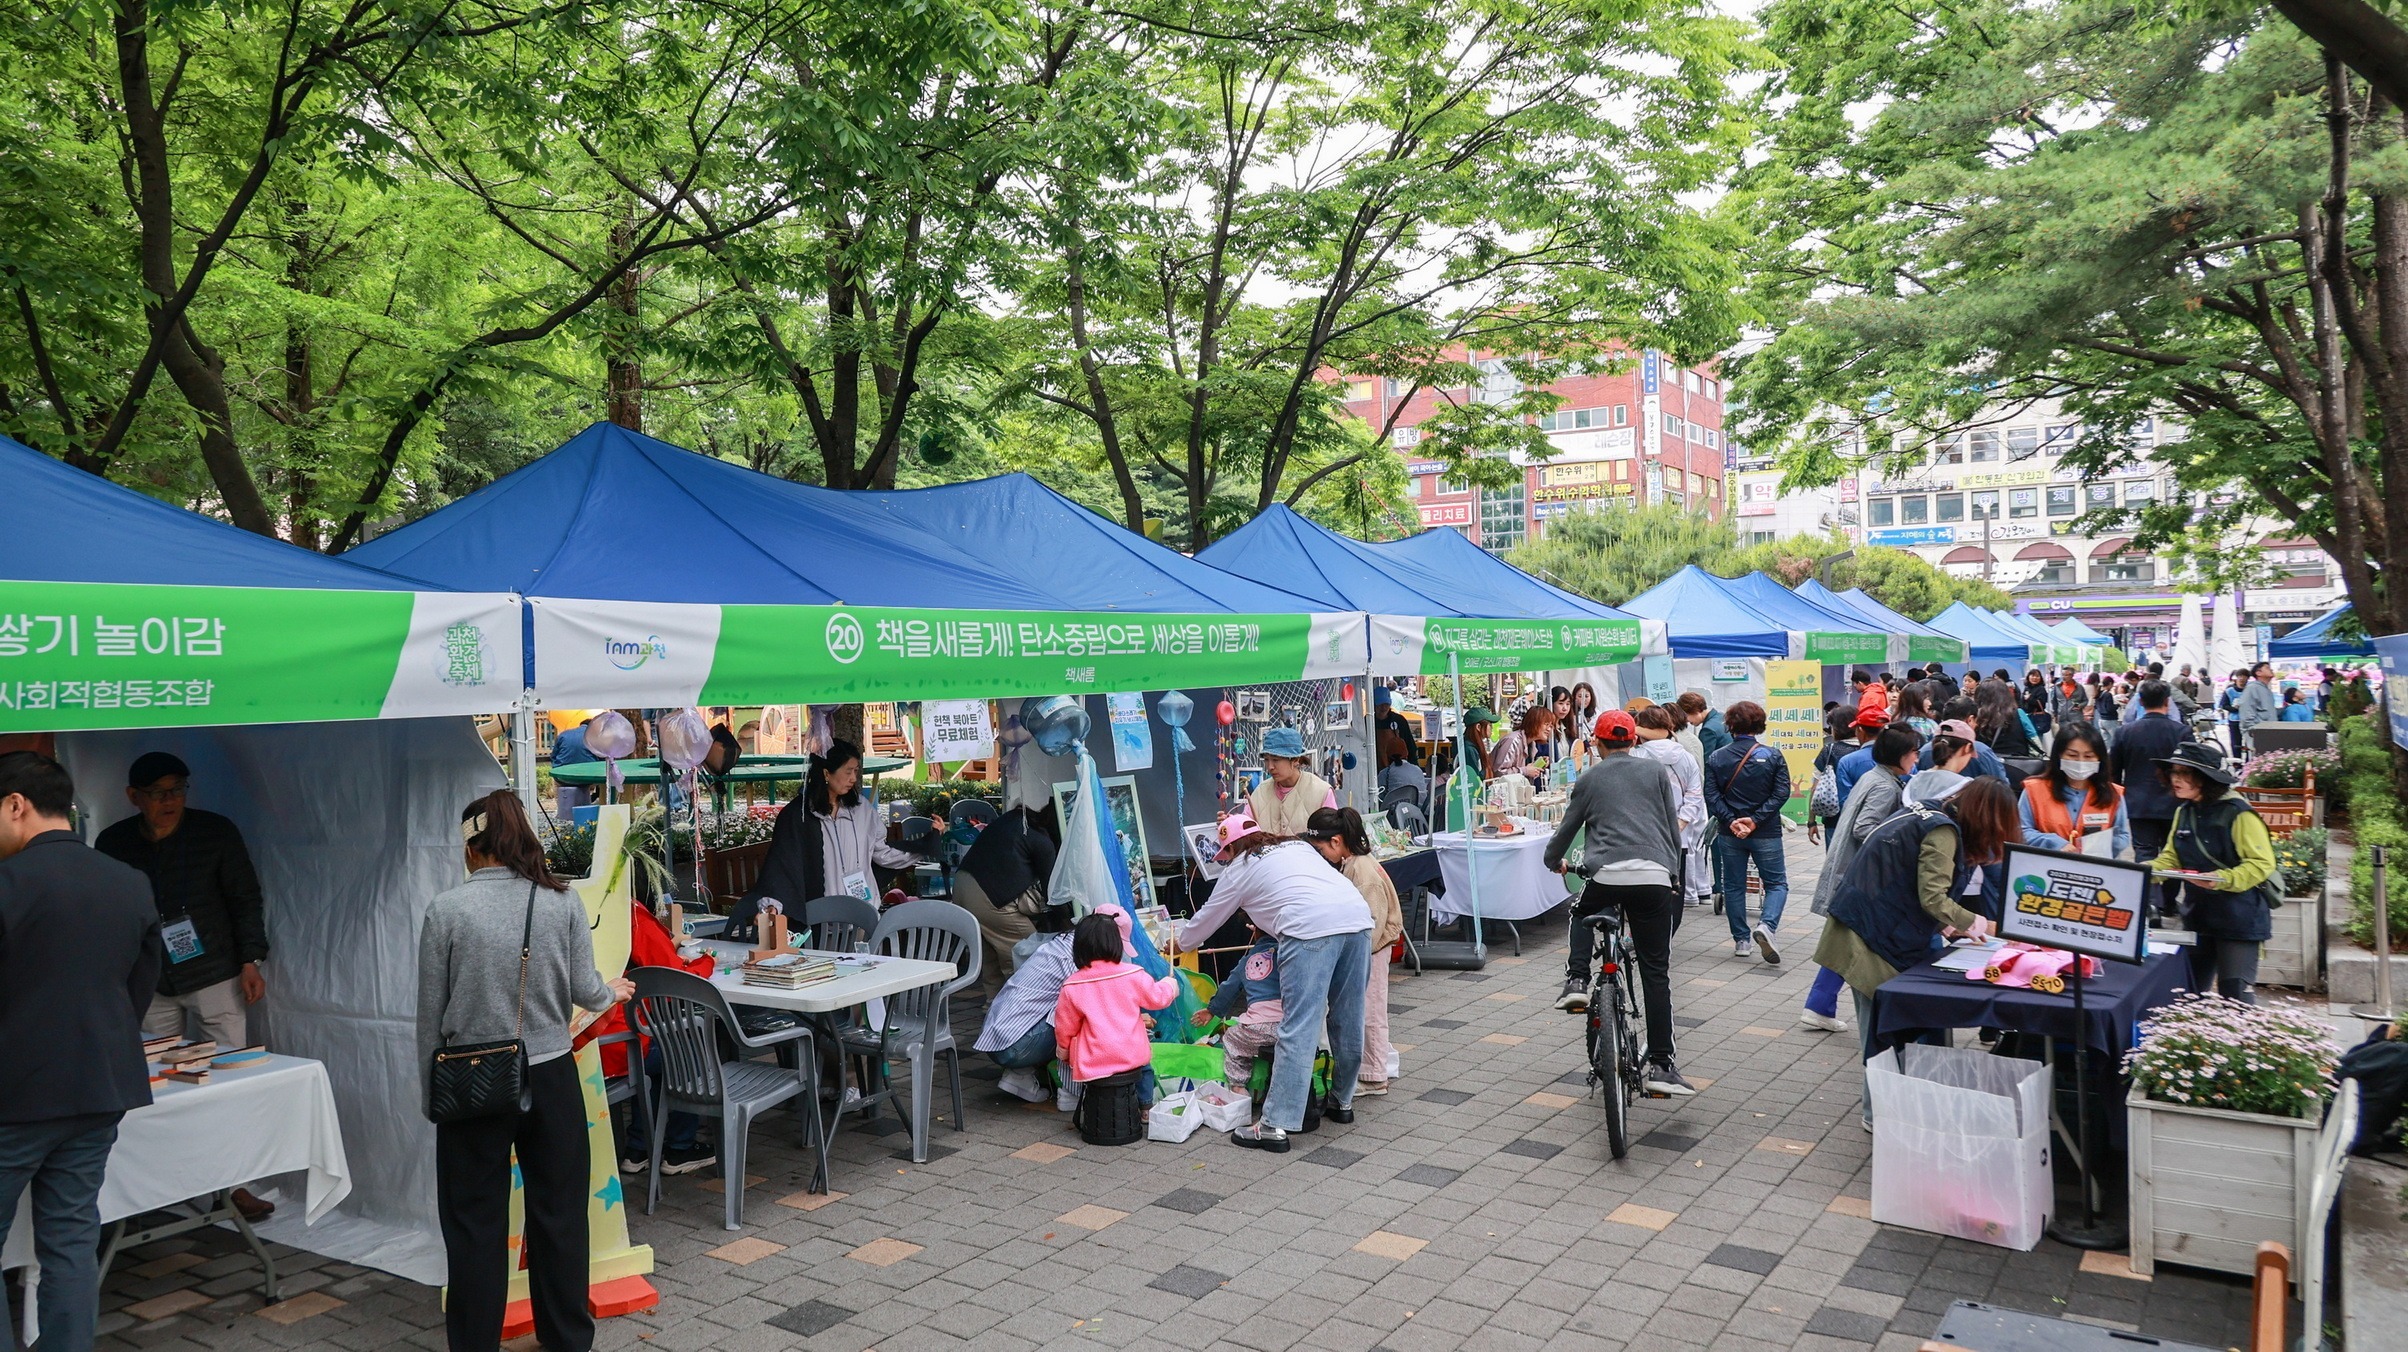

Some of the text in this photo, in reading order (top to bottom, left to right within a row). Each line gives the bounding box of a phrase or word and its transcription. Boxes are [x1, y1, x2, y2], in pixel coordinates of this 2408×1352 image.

[1556, 465, 1582, 477] 한수위
[2016, 493, 2029, 505] 방
[1421, 508, 1465, 522] 물리치료
[2050, 600, 2071, 610] CU
[94, 615, 226, 656] 놀이감
[447, 626, 478, 645] 과천
[830, 624, 859, 651] 20
[1018, 622, 1146, 657] 탄소중립으로
[1151, 623, 1204, 655] 세상을
[1208, 623, 1260, 653] 이롭게!
[1445, 628, 1469, 651] 지구를
[1470, 628, 1492, 651] 살리는
[448, 645, 479, 663] 환경
[450, 662, 481, 681] 축제
[1065, 667, 1095, 683] 책새롬
[0, 679, 215, 710] 사회적협동조합
[933, 713, 978, 727] 헌책 북아트
[938, 727, 979, 743] 무료체험
[1771, 729, 1819, 738] 세대와 세대가
[1773, 742, 1794, 751] 세상을
[2049, 882, 2096, 903] 도전!
[2017, 893, 2132, 931] 환경골든벨
[2018, 918, 2050, 930] 사전접수
[2052, 924, 2068, 934] 확인
[1985, 969, 2000, 978] 68
